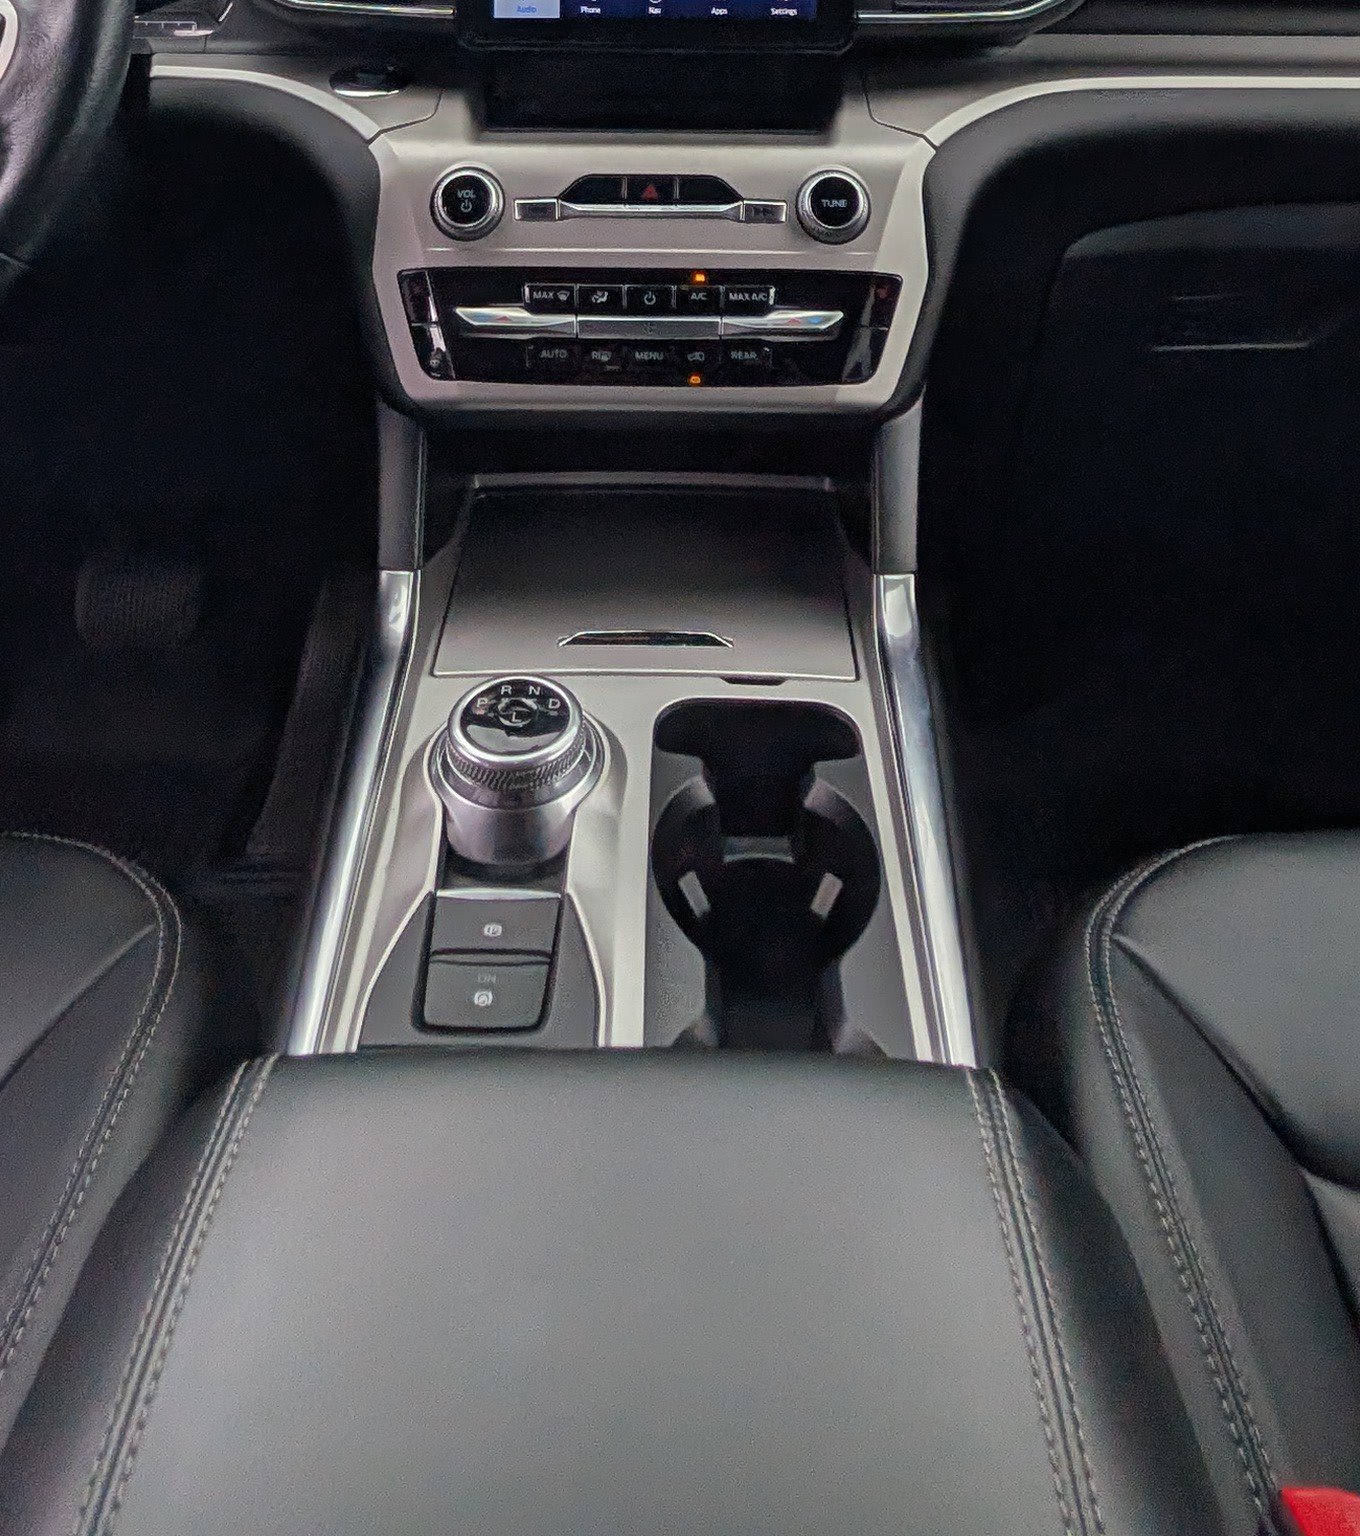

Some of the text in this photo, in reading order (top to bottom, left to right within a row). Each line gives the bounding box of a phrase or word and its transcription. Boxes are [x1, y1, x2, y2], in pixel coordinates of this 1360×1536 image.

[516, 5, 537, 14] Audio
[580, 5, 601, 14] Phone
[648, 6, 662, 15] Nav
[710, 7, 728, 16] Apps
[770, 7, 798, 17] Settings
[457, 189, 476, 198] VOL
[821, 199, 848, 208] TUNE
[533, 290, 554, 300] MAX
[690, 292, 708, 301] A/C
[729, 292, 768, 302] MAX A/C
[540, 349, 568, 359] AUTO
[634, 351, 665, 361] MENU
[500, 685, 541, 695] R N
[477, 697, 561, 709] P D
